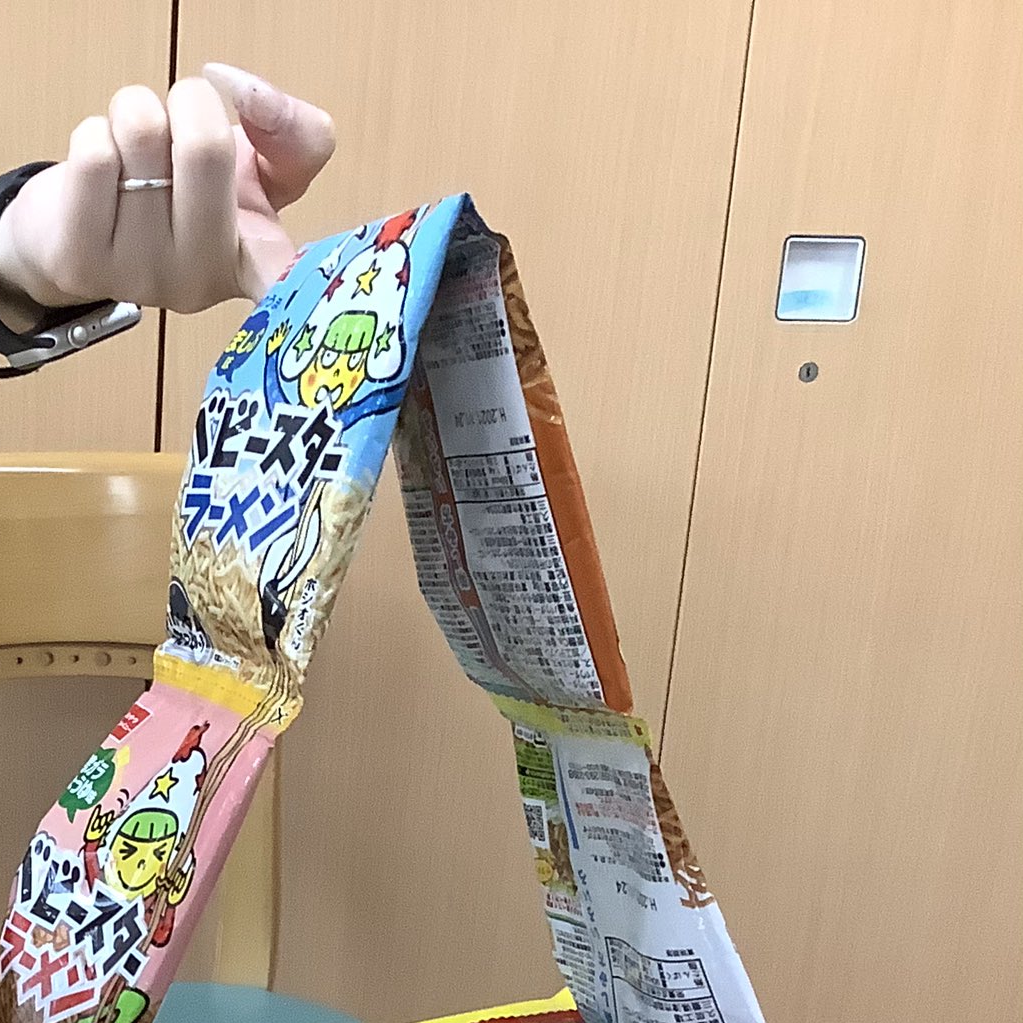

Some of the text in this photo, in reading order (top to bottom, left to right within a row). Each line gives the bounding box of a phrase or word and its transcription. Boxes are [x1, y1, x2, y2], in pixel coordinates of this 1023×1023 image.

[184, 473, 296, 552] ラーメン
[0, 910, 98, 1017] ラーメン
